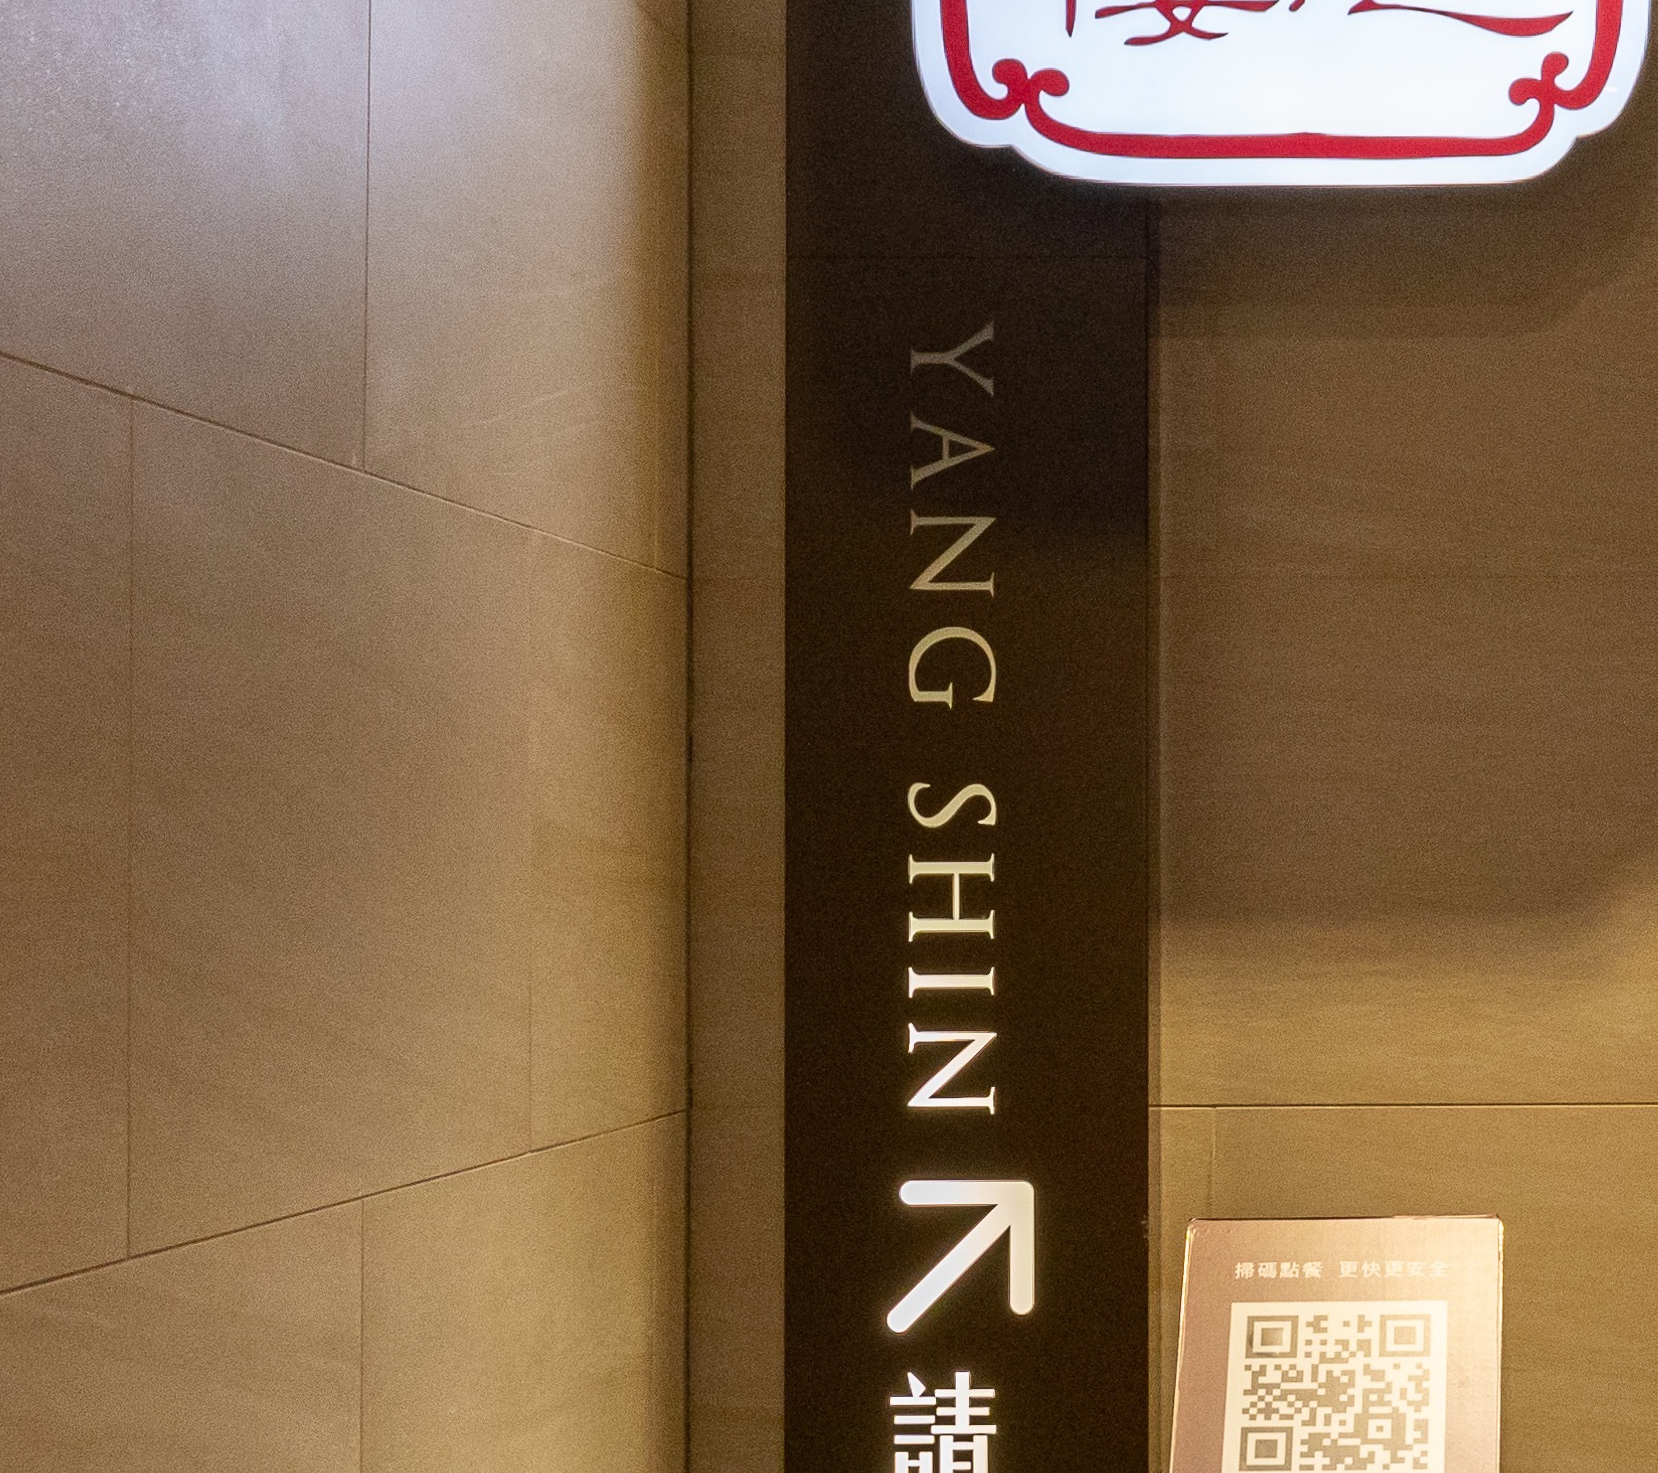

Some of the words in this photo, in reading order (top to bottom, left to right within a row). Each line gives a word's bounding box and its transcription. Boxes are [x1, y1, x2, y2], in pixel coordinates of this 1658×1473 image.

[908, 321, 998, 710] YANG
[907, 781, 998, 1116] SHIN
[1234, 1261, 1324, 1280] 掃碼點餐
[1338, 1260, 1450, 1278] 更快更安全
